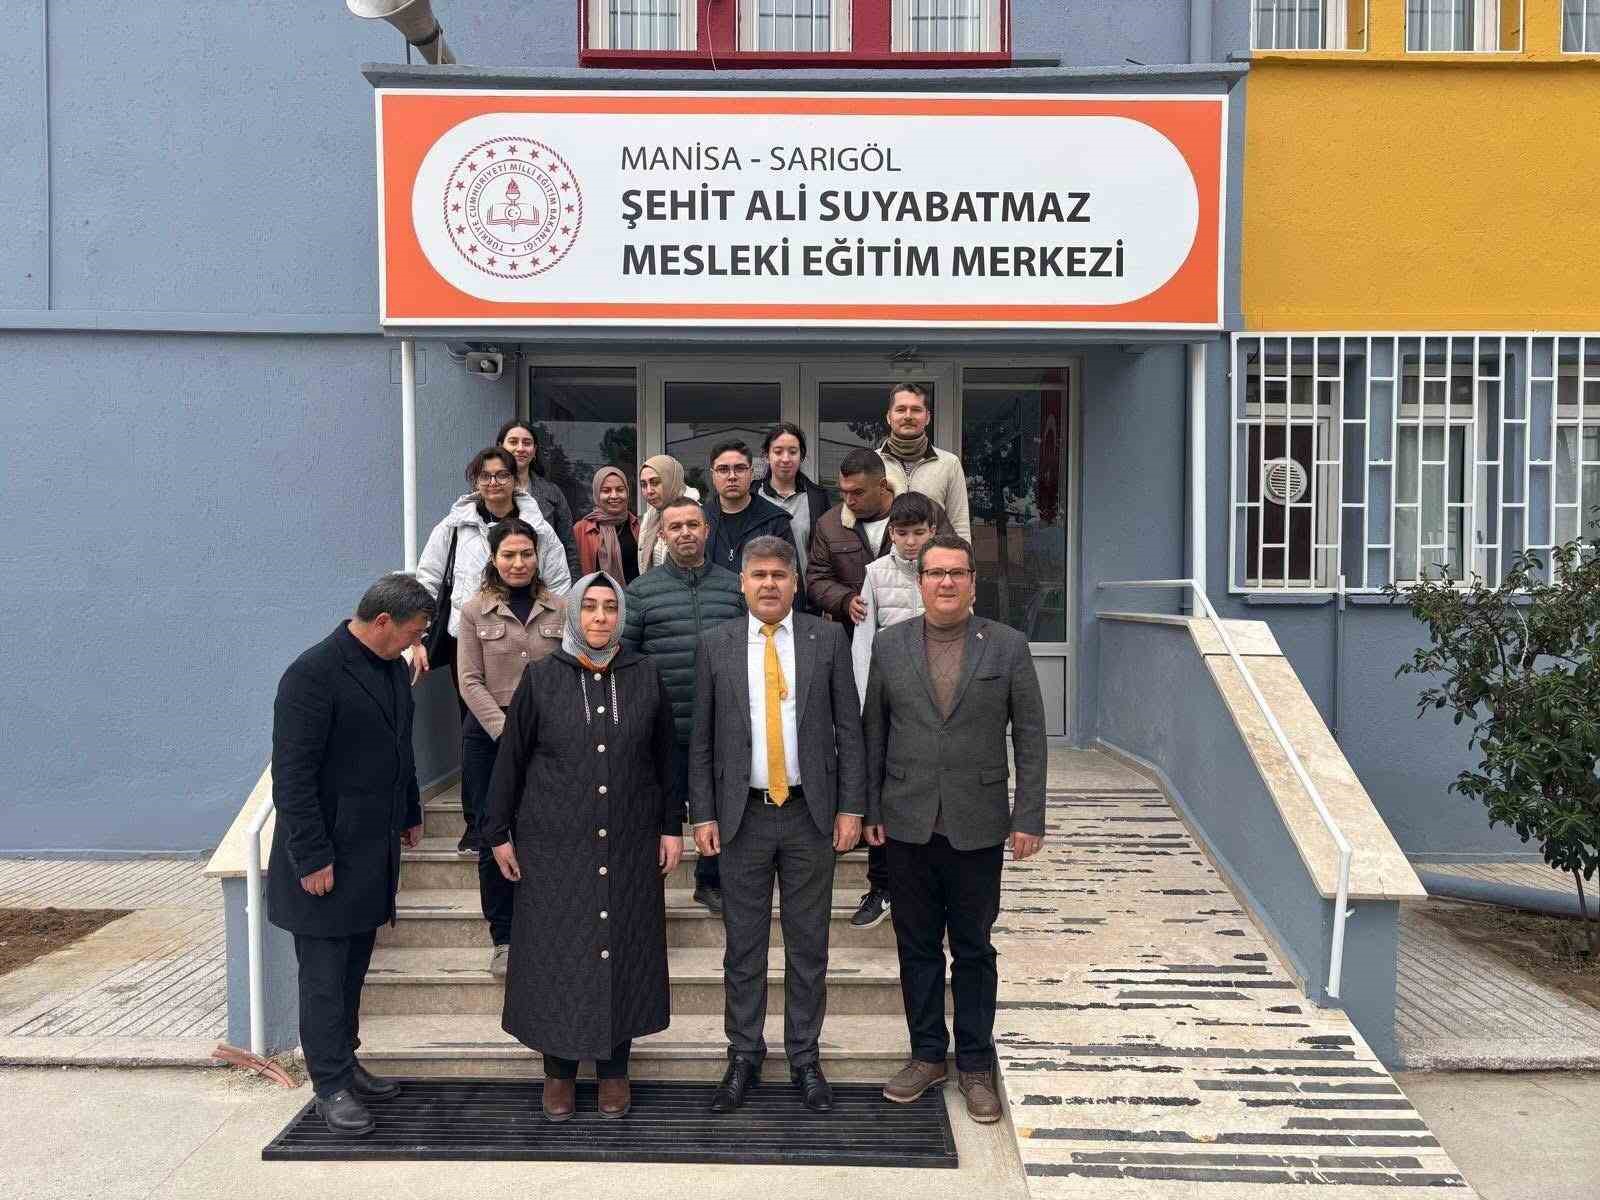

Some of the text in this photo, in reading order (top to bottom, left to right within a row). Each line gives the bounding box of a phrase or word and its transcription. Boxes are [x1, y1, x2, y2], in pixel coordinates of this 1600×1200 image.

[509, 162, 536, 176] MİLLİ
[621, 141, 742, 171] MANİSA
[770, 142, 902, 172] SARIGÖL
[468, 162, 507, 218] CUMHURİYETİ
[536, 173, 557, 205] EĞİTİM
[621, 182, 1091, 230] ŞEHİT ALİ SUYABATMAZ
[523, 208, 558, 251] BAKANLIĞI
[622, 236, 1125, 278] MESLEKİ EĞİTİM MERKEZİ
